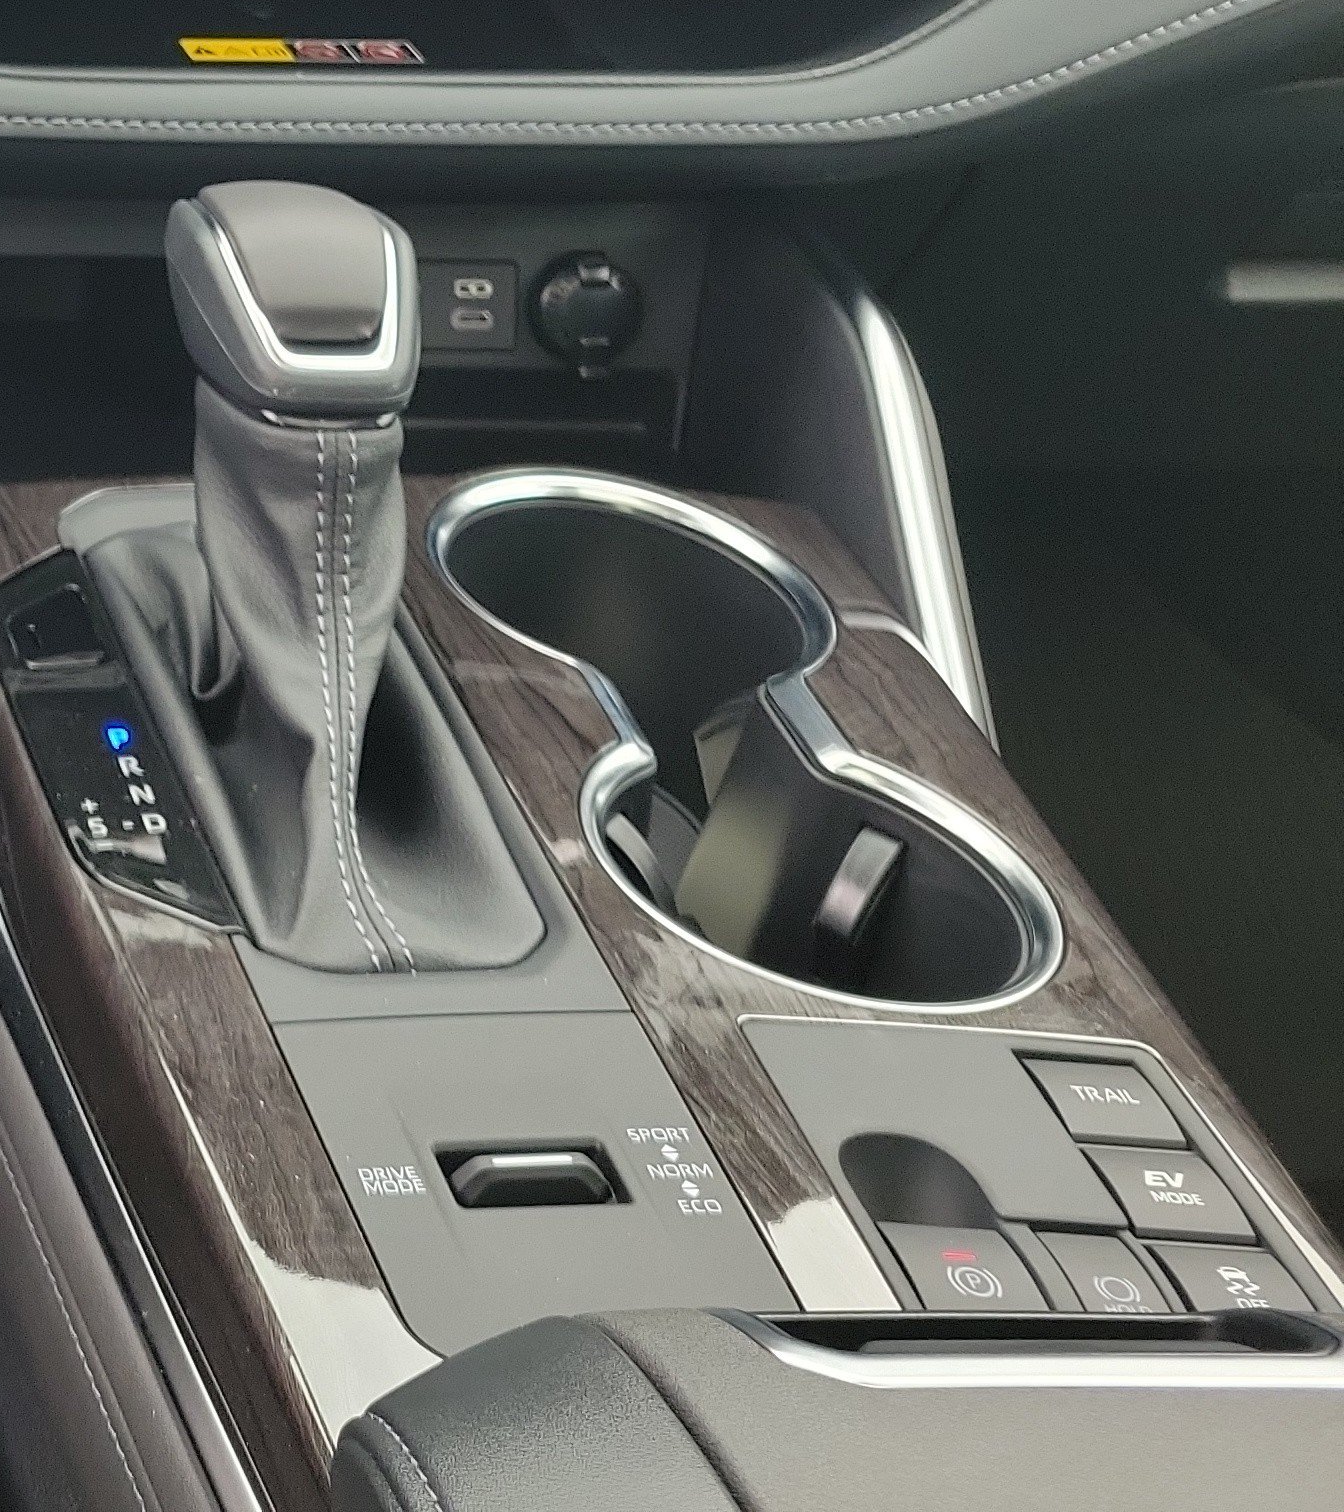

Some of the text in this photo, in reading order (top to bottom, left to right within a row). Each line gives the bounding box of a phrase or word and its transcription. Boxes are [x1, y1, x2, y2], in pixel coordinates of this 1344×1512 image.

[107, 726, 130, 750] P
[117, 754, 145, 779] R
[128, 783, 157, 806] N
[87, 817, 108, 839] S
[141, 813, 168, 836] D
[1069, 1083, 1141, 1107] TRAIL
[626, 1126, 691, 1144] SPORT
[357, 1164, 419, 1183] DRIVE
[646, 1162, 714, 1180] NORM
[1143, 1169, 1185, 1189] EV
[362, 1178, 427, 1197] MODE
[676, 1198, 723, 1215] ECO
[1149, 1190, 1206, 1207] MODE
